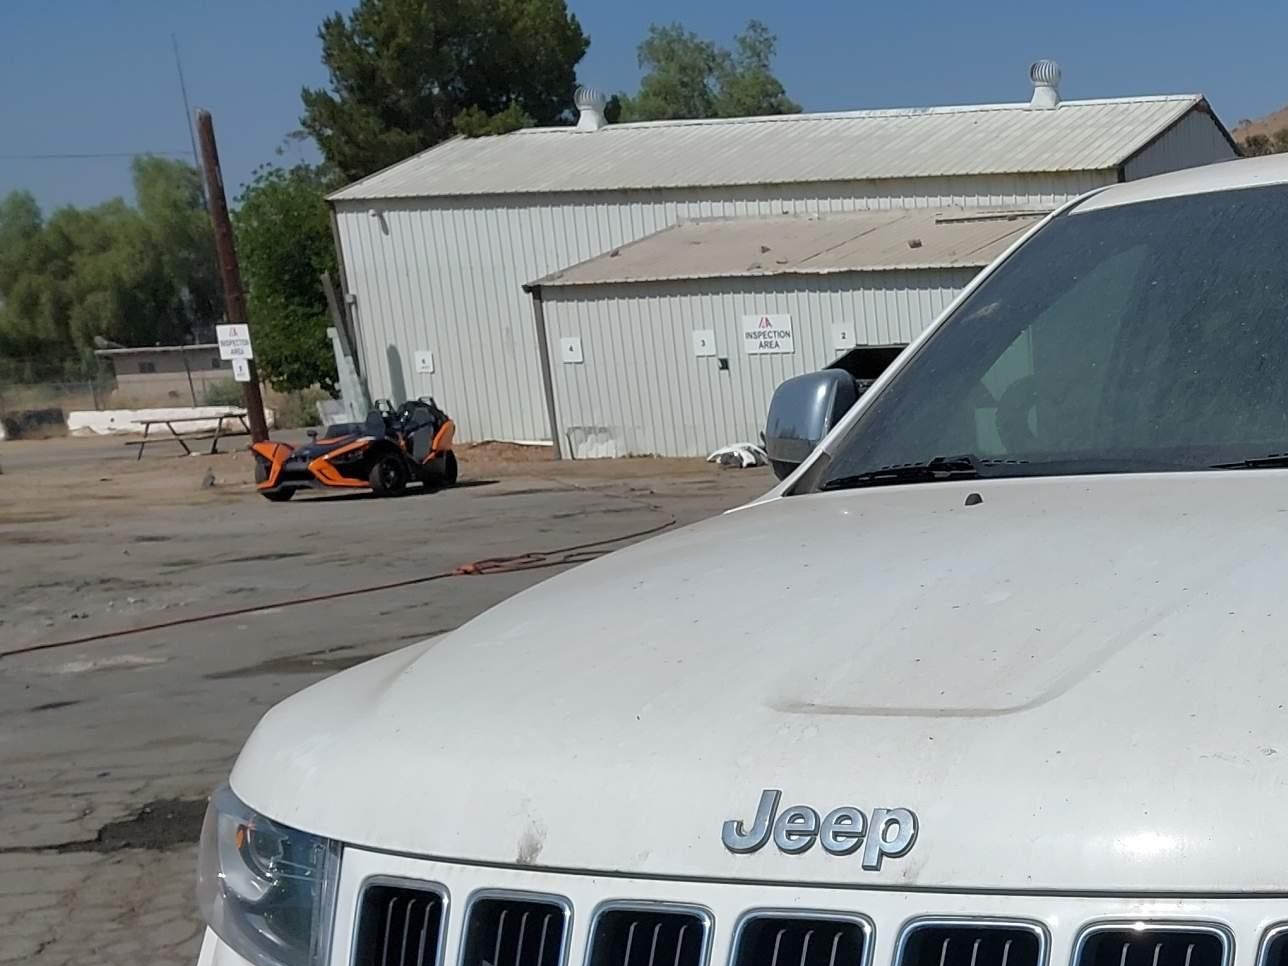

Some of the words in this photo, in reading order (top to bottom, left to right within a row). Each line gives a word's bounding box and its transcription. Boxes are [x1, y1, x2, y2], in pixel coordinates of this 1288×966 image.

[745, 330, 791, 340] INSPECTION
[840, 331, 847, 340] 2
[758, 340, 780, 350] AREA
[721, 788, 920, 872] Jeep
